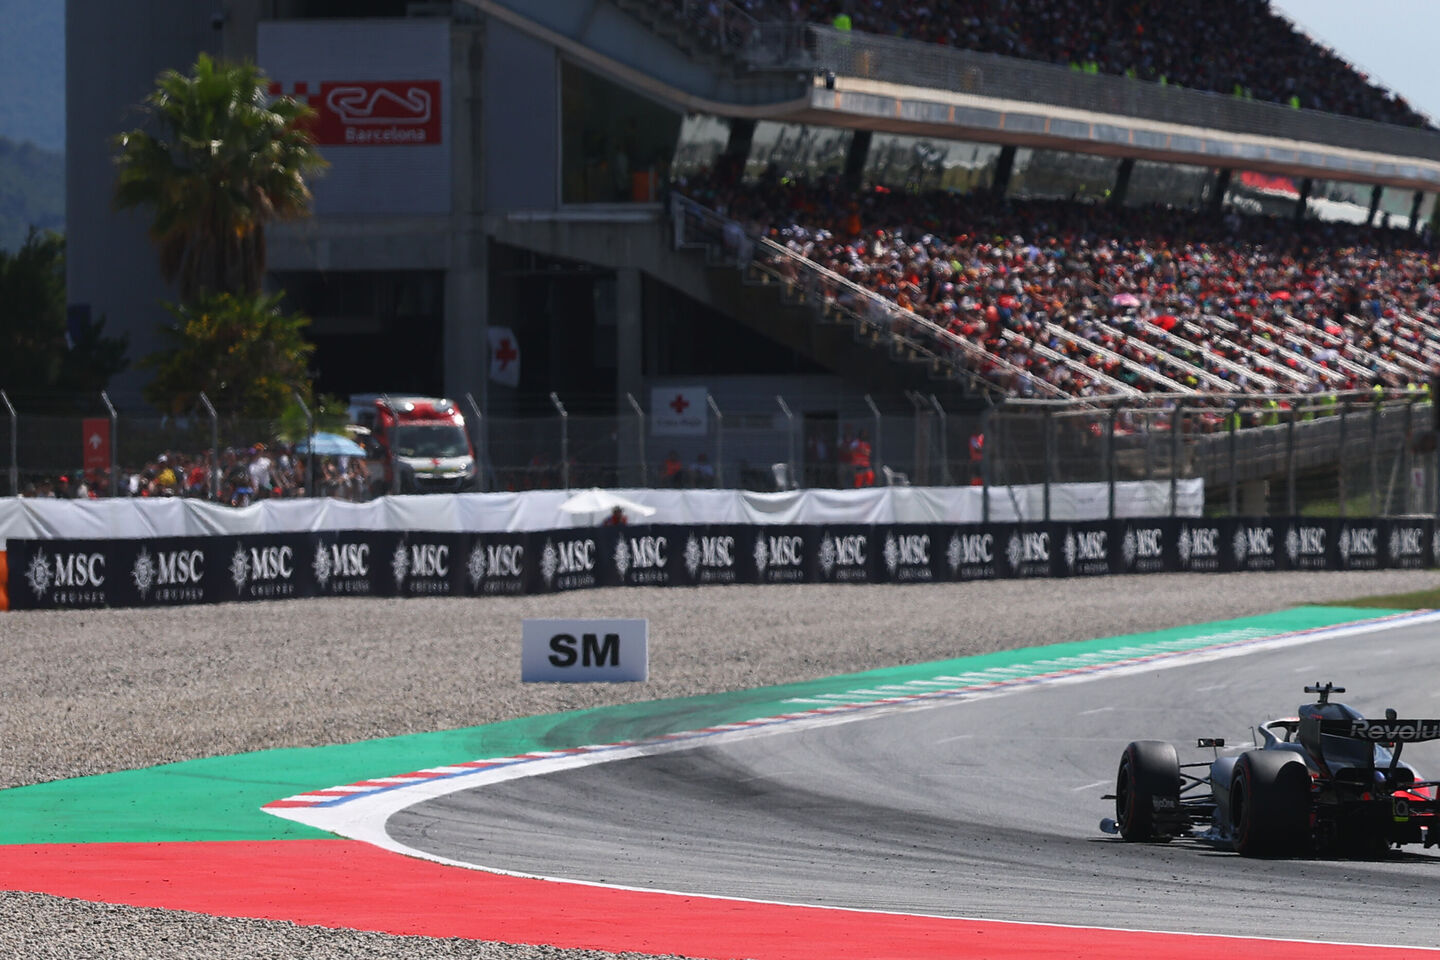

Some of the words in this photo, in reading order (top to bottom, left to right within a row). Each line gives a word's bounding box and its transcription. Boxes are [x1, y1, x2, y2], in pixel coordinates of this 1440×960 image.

[250, 546, 293, 580] MSC
[331, 544, 370, 576] MSC
[411, 544, 449, 577] MSC
[486, 544, 524, 577] MSC
[557, 539, 595, 573] MSC
[631, 536, 668, 568] MSC
[701, 535, 735, 567] MSC
[769, 535, 803, 567] MSC
[835, 534, 867, 565] MSC
[899, 534, 930, 565] MSC
[54, 553, 105, 587] MSC
[157, 550, 204, 584] MSC
[548, 633, 620, 667] SM
